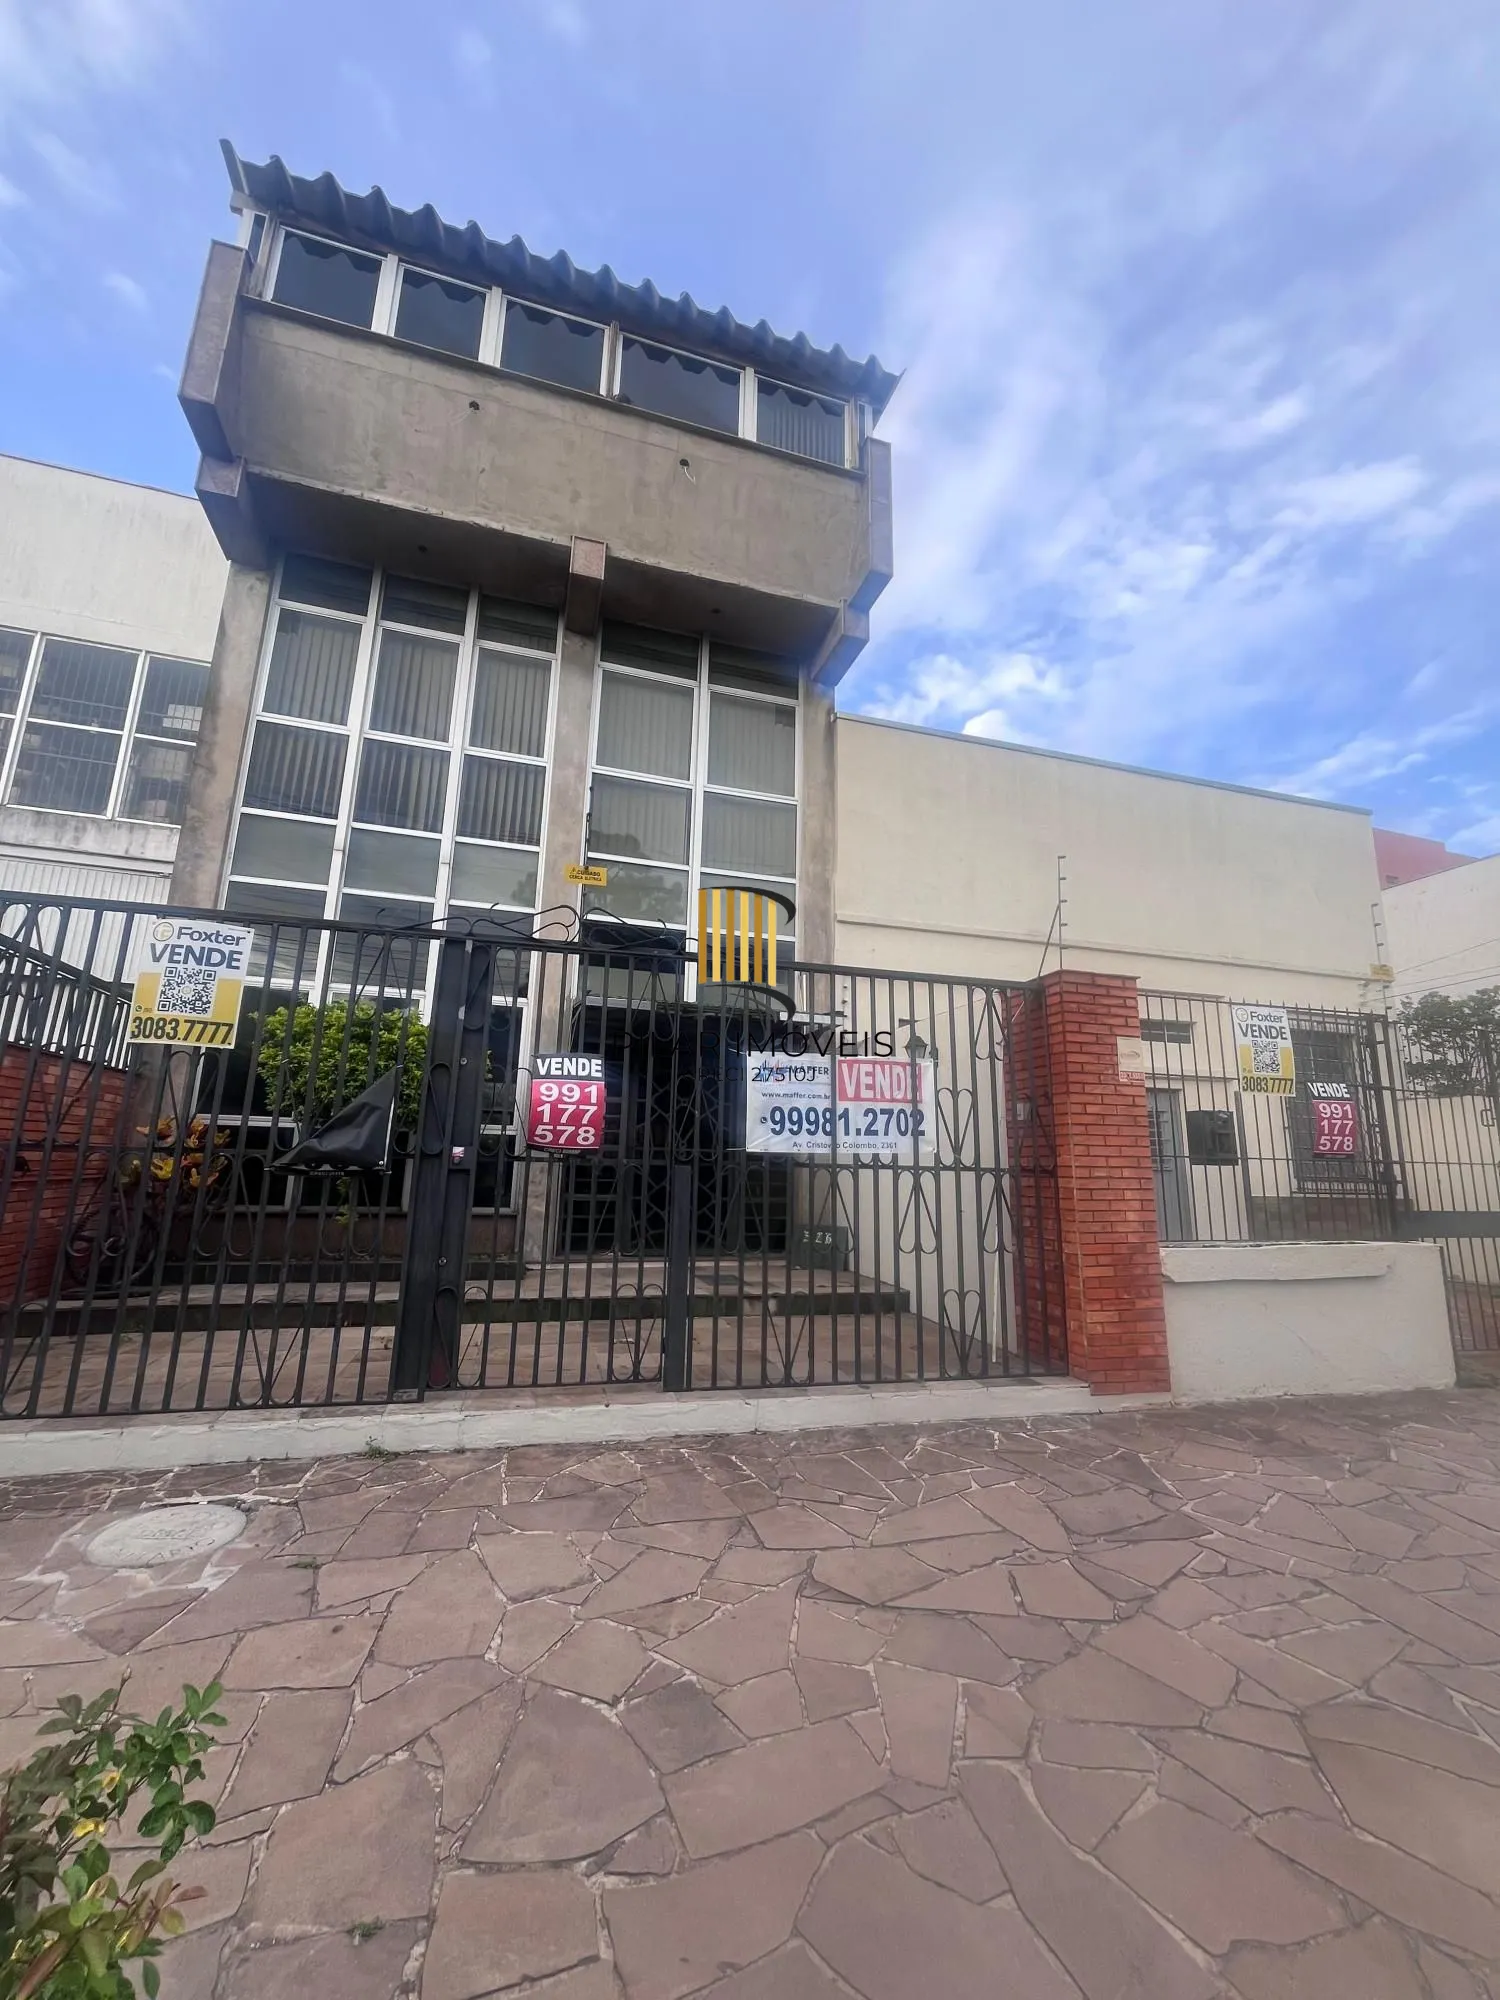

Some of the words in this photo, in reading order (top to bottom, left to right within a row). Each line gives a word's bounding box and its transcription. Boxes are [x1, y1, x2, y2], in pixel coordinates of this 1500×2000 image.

[177, 926, 246, 946] Foxter
[150, 943, 243, 970] VENDE
[1250, 1011, 1284, 1023] Foxter
[131, 1016, 234, 1045] 3083.7777
[1238, 1023, 1288, 1040] VENDE
[536, 1057, 602, 1077] VENDE
[540, 1083, 598, 1103] 991
[1307, 1082, 1350, 1097] VENDE
[536, 1103, 598, 1124] 177
[1318, 1103, 1353, 1118] 991
[769, 1106, 926, 1136] 99981.2702
[1320, 1120, 1354, 1134] 177
[533, 1125, 596, 1145] 578
[1318, 1136, 1353, 1151] 578
